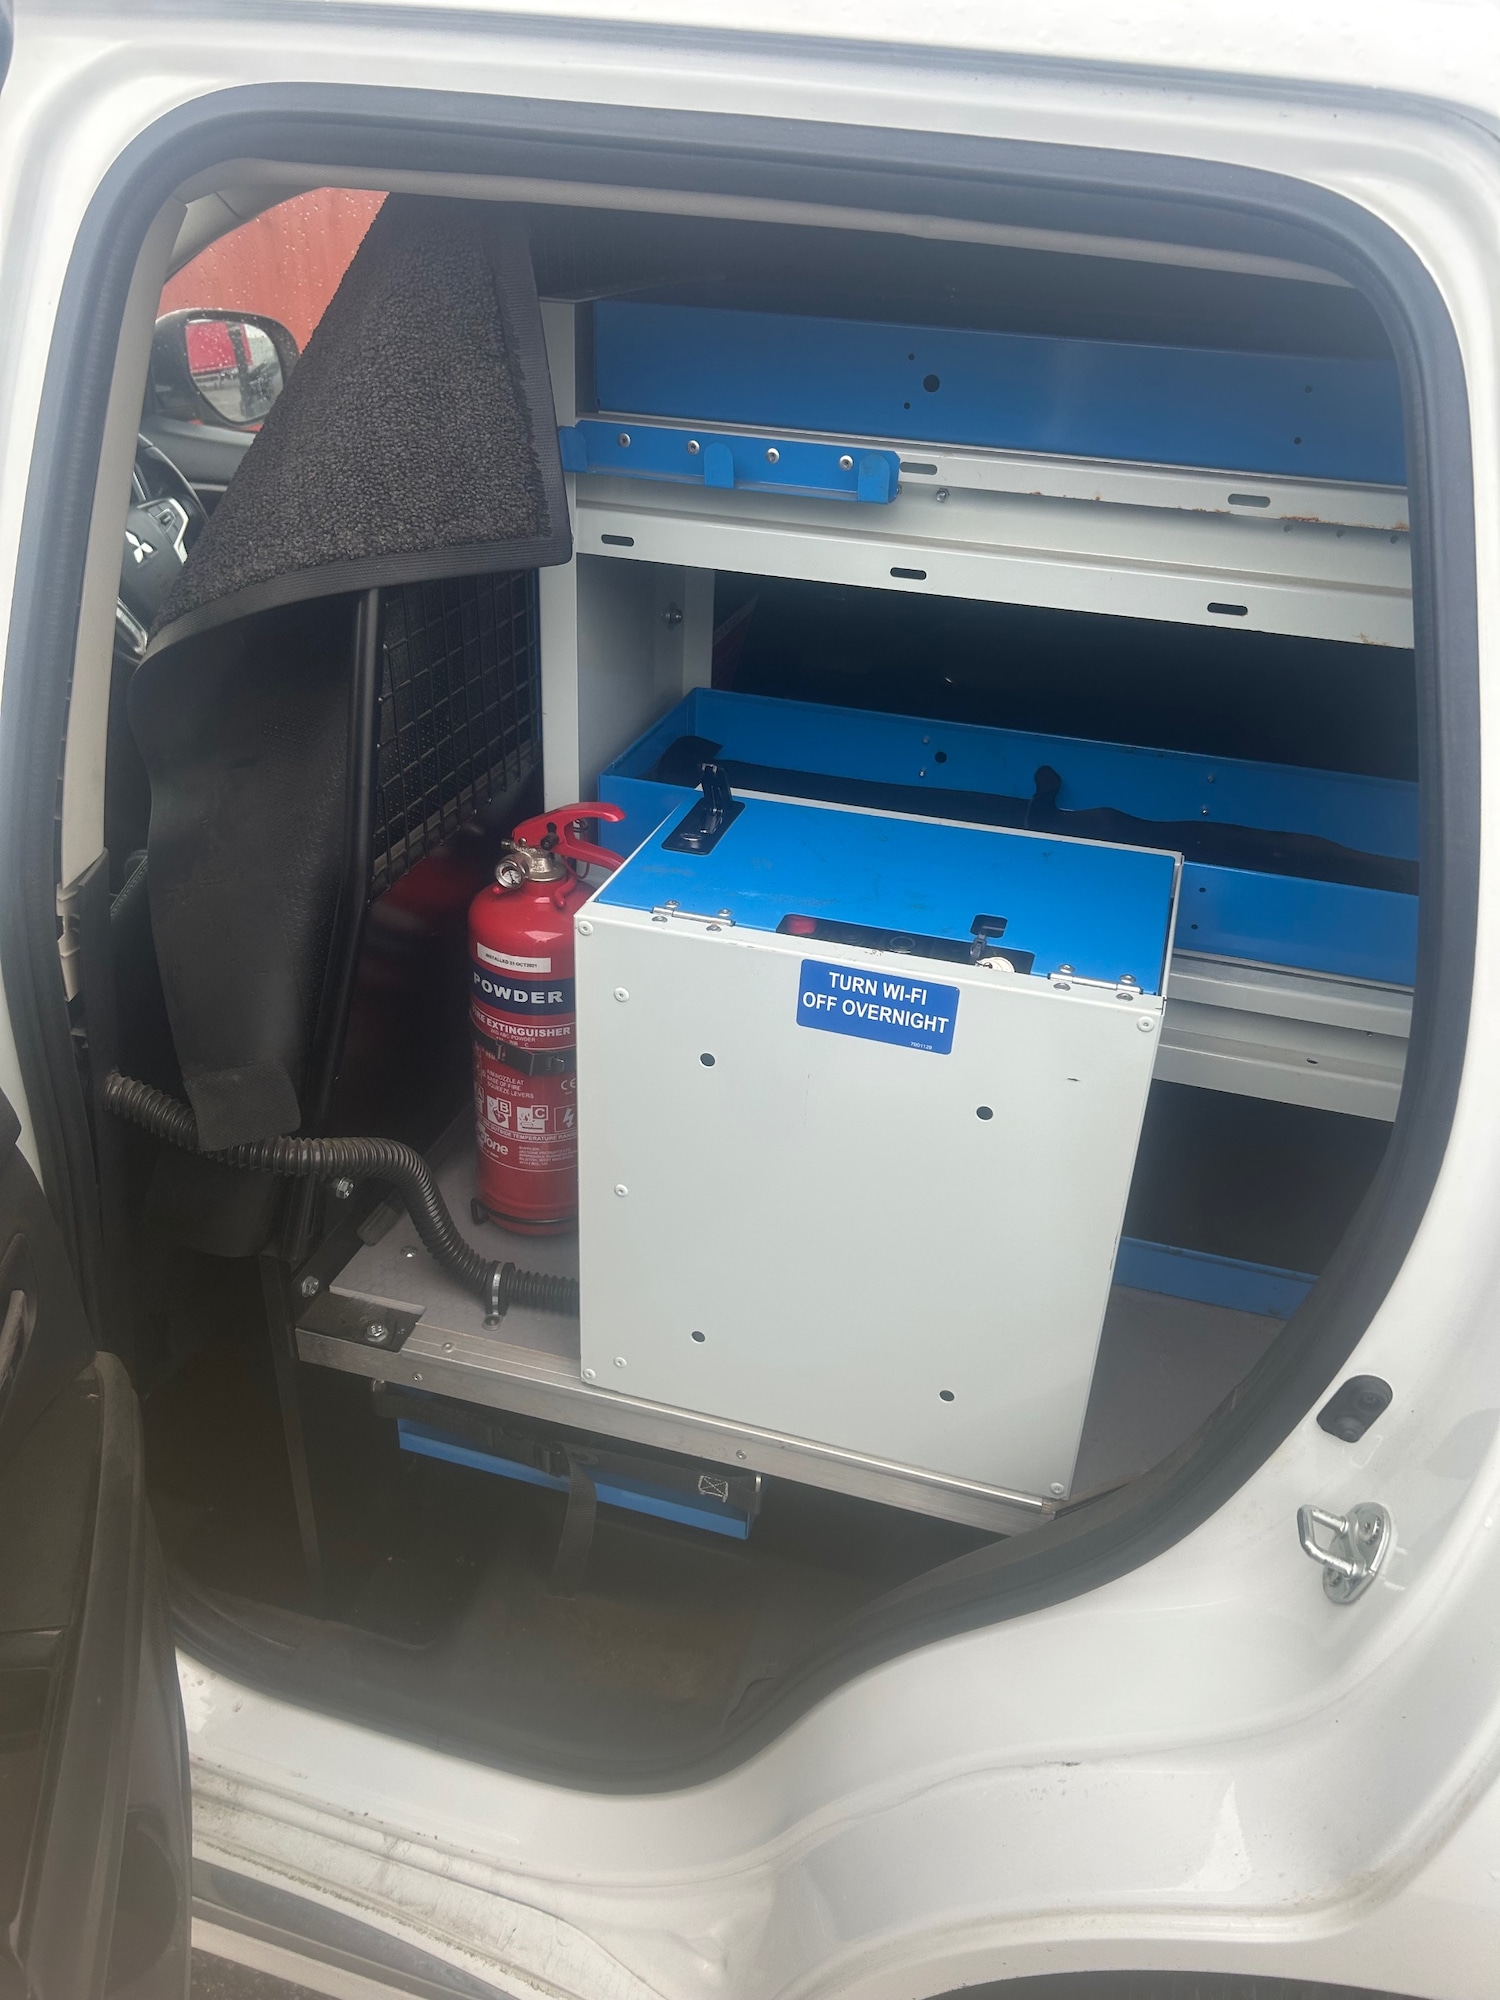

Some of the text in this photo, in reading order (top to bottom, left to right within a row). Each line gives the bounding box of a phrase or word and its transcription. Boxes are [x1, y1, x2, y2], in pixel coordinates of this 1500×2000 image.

[485, 953, 509, 965] INSTALLED
[473, 971, 564, 1004] POWDER
[829, 971, 928, 1006] TURN WI-FI
[802, 991, 950, 1034] OFF OVERNIGHT
[486, 1018, 571, 1038] EXTINGUISHER
[510, 1089, 534, 1099] LEVERS
[500, 1101, 509, 1113] B
[534, 1107, 546, 1118] C
[512, 1132, 557, 1141] TEMPERATURE
